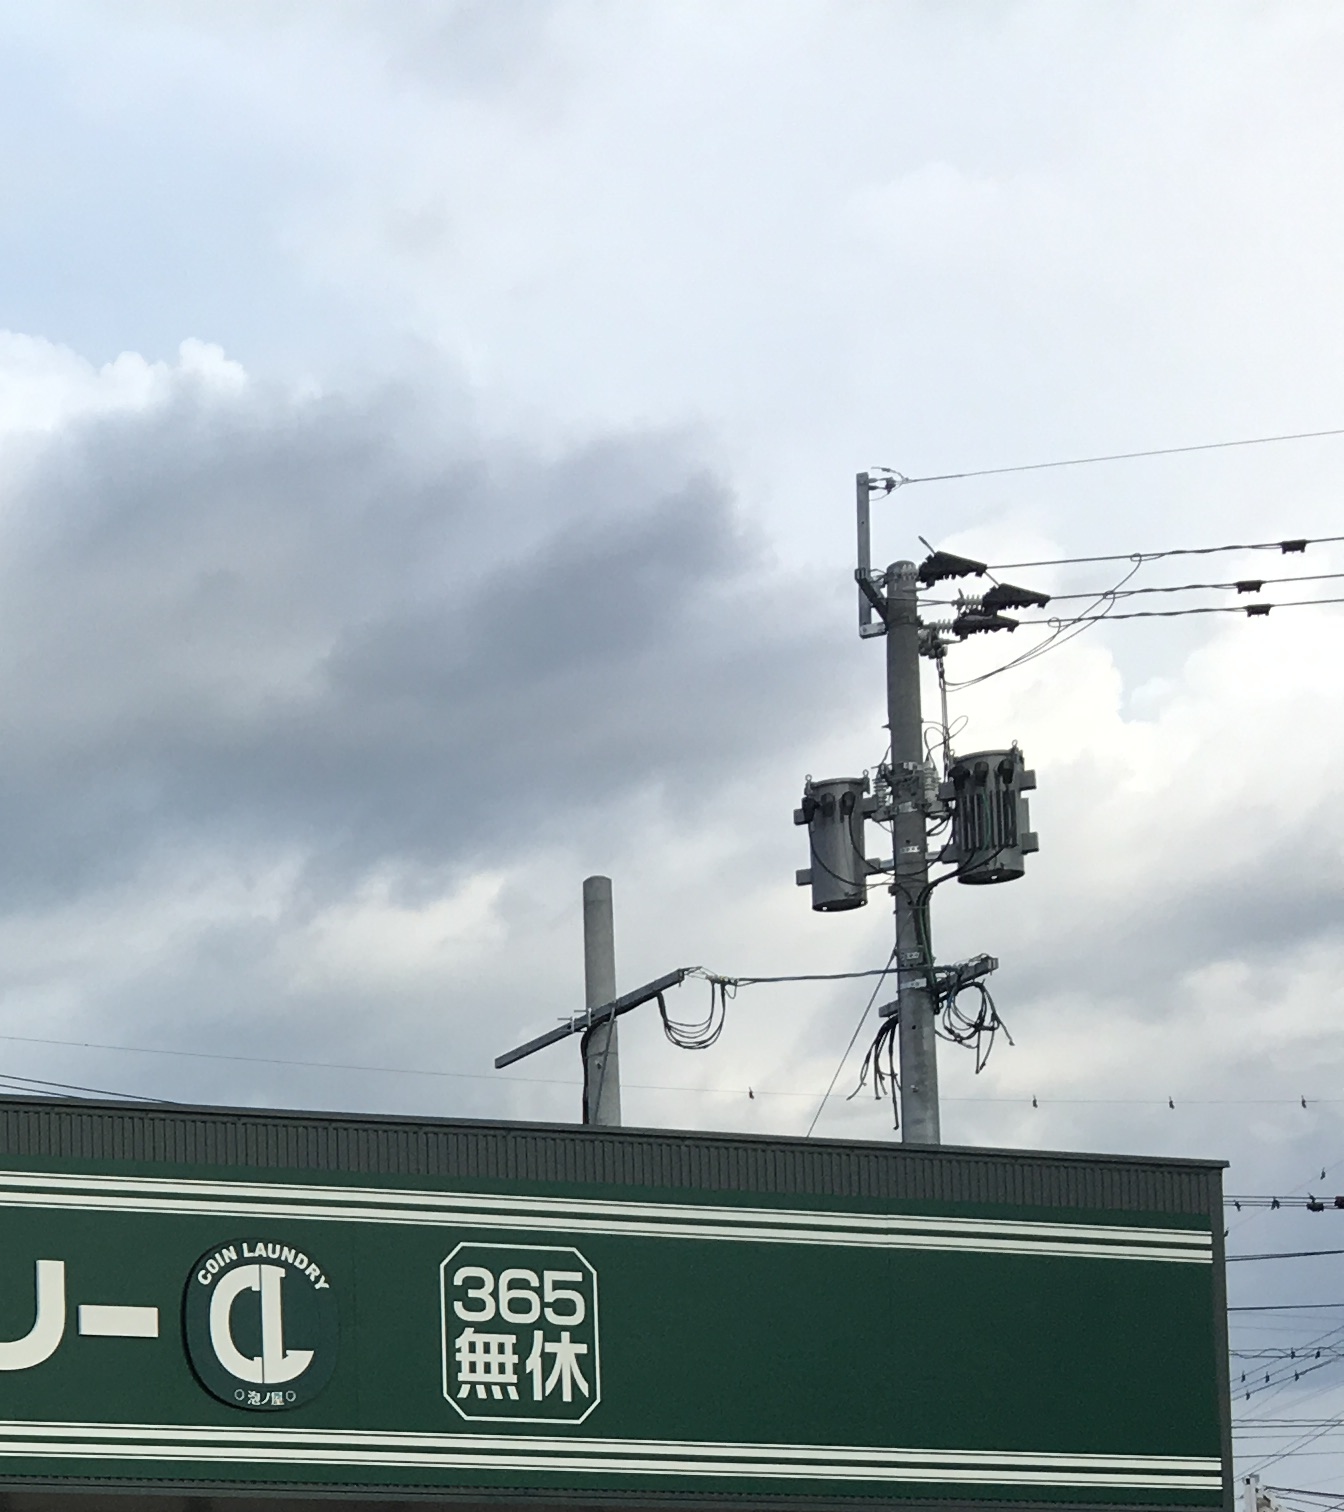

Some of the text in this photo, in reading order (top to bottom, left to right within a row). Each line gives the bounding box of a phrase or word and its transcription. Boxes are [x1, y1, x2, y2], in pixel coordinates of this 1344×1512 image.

[196, 1241, 331, 1291] COIN LAUNDRY
[453, 1261, 589, 1326] 365
[450, 1325, 592, 1405] 無休
